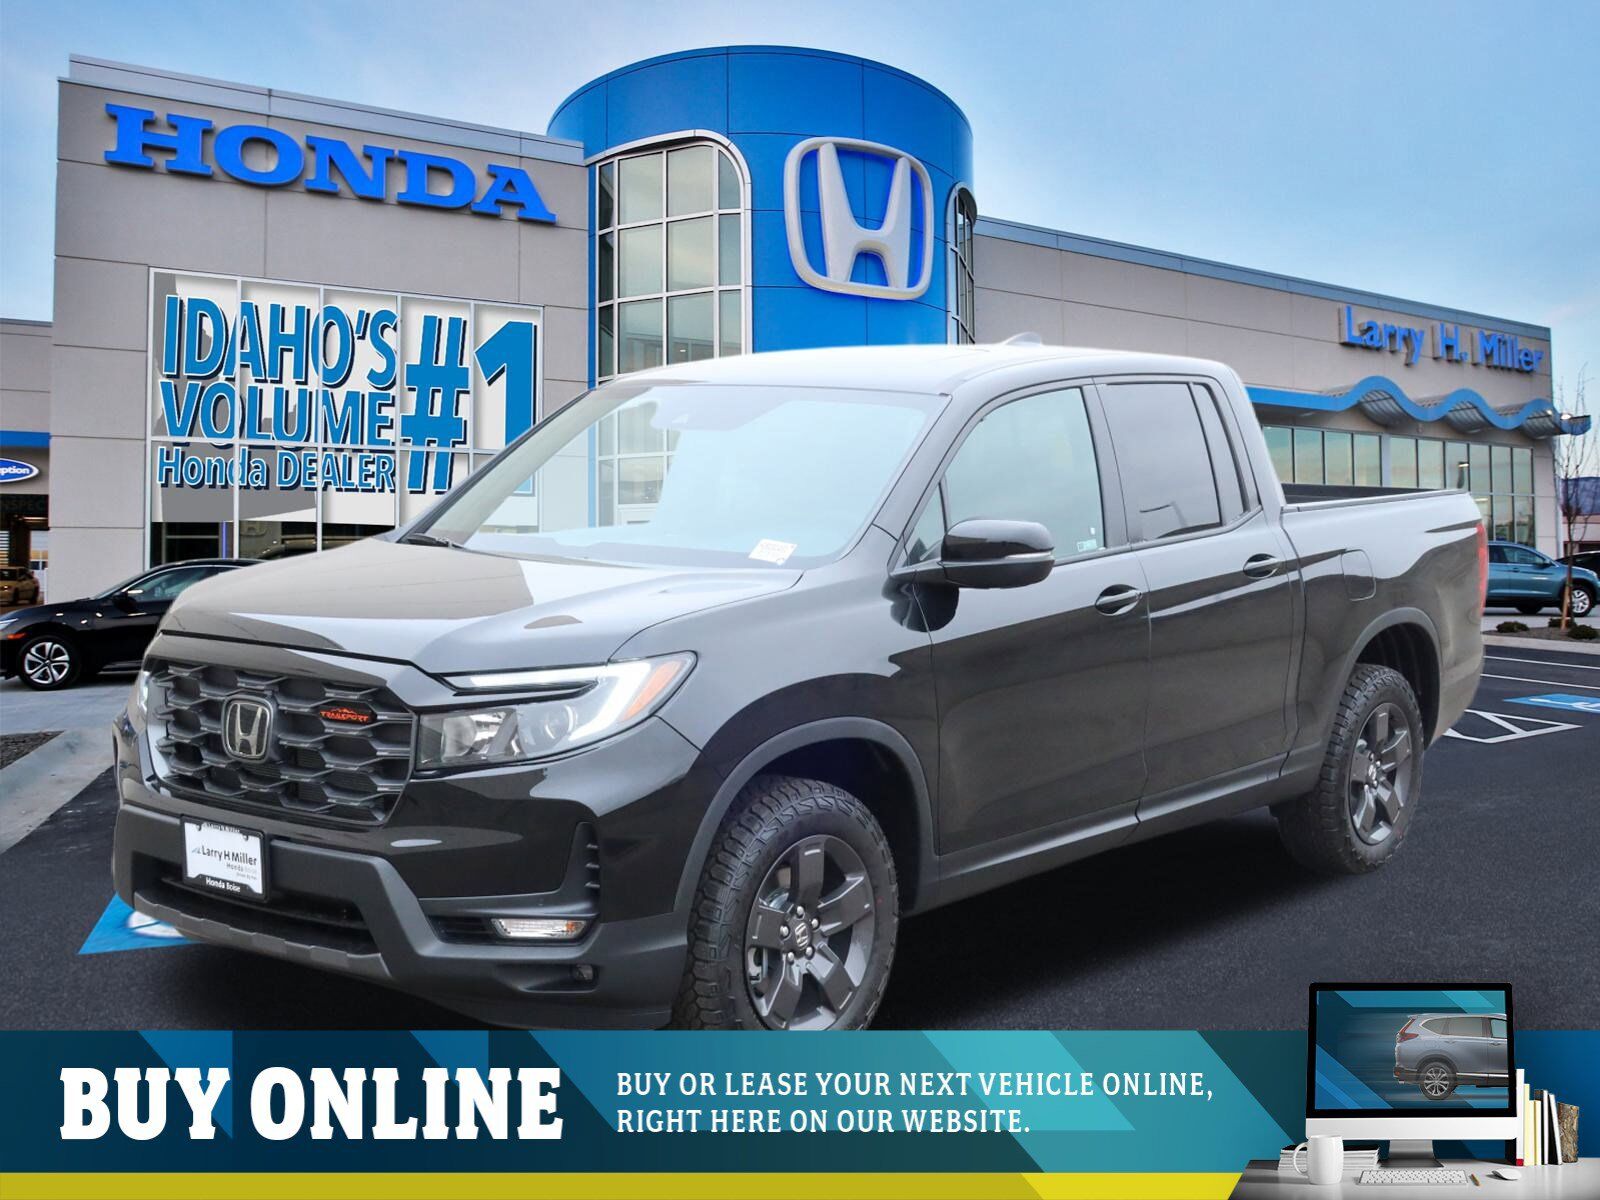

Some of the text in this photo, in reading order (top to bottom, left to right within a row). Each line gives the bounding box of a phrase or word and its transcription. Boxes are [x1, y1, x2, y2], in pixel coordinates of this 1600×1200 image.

[104, 103, 557, 223] HONDA
[162, 294, 398, 393] IDAHO'S
[1343, 305, 1544, 372] Larry H. Miller
[160, 381, 395, 453] VOLUME
[0, 465, 30, 476] ption
[157, 446, 396, 493] Honda DEALER
[201, 845, 222, 862] Larry
[232, 852, 257, 866] Miller
[205, 876, 225, 889] Honda
